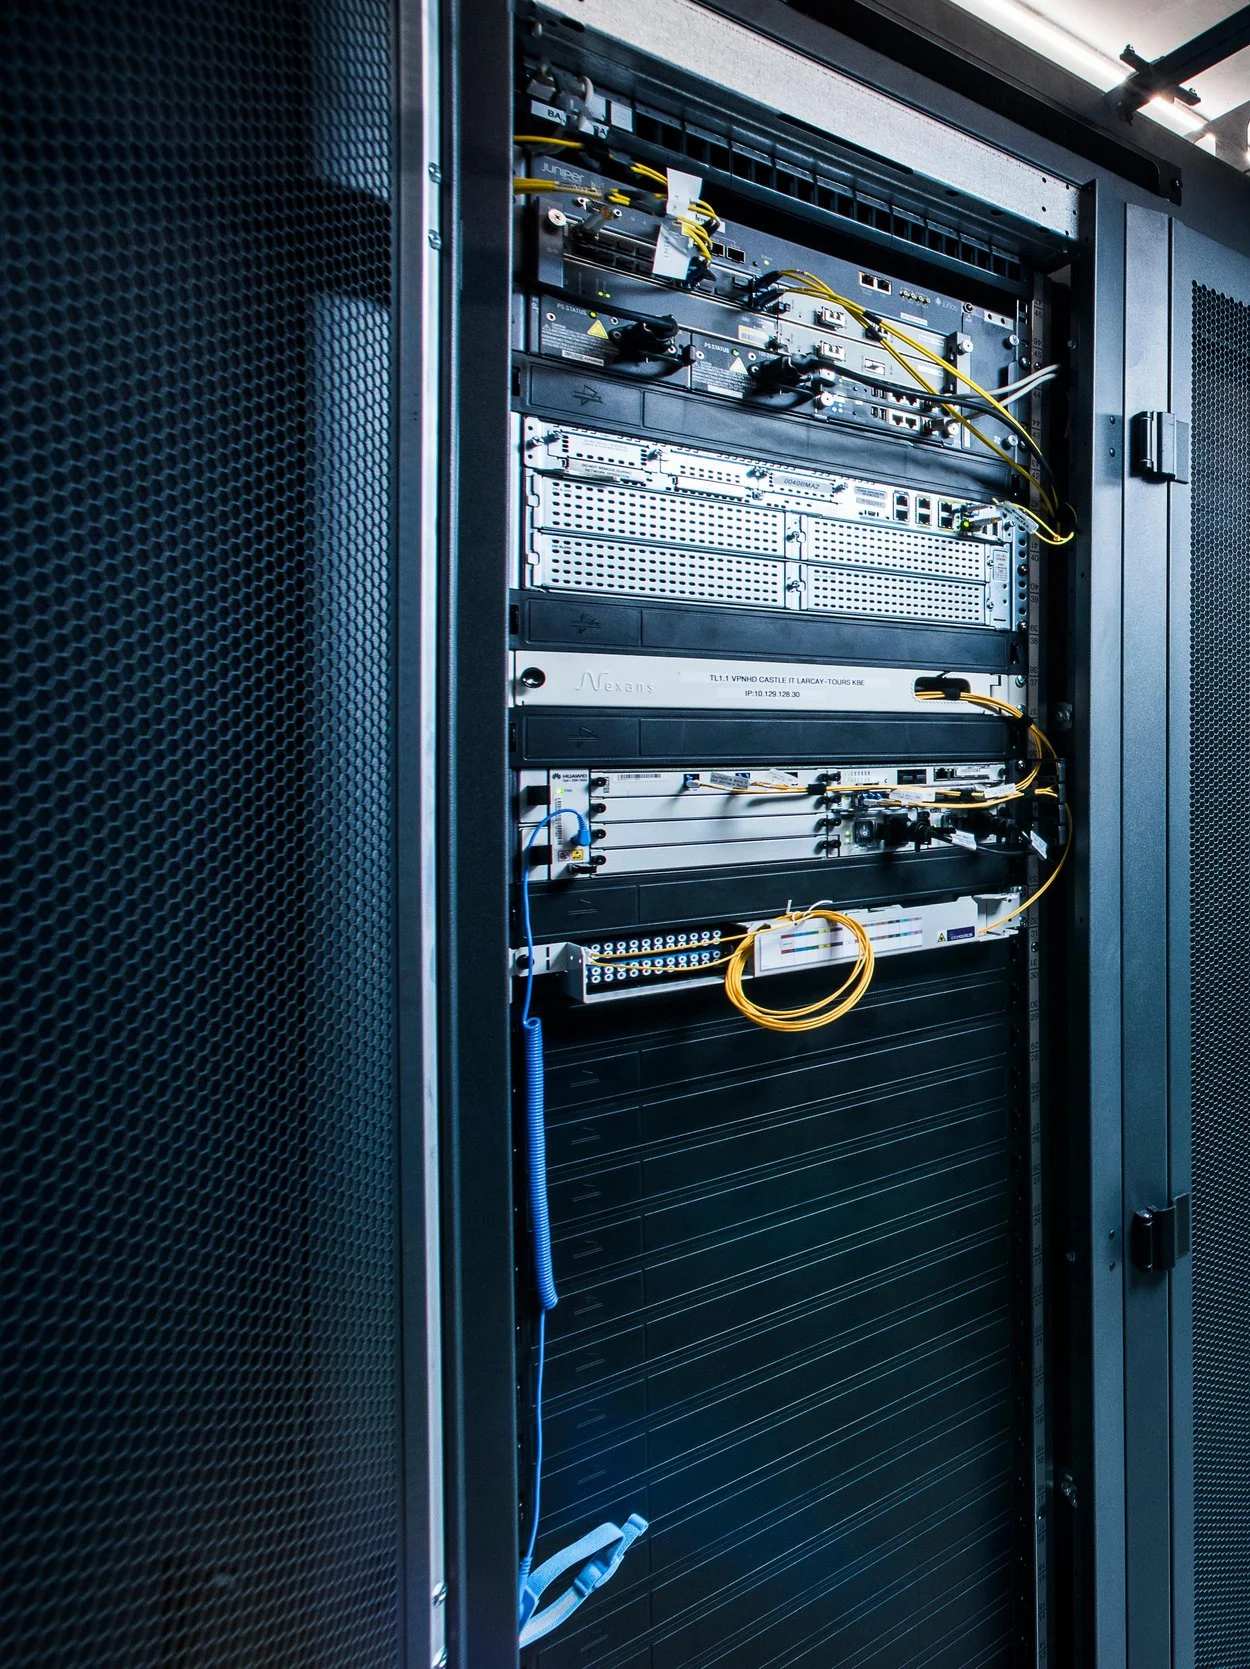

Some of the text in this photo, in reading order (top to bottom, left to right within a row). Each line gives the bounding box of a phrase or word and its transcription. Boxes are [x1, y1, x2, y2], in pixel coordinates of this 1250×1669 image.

[575, 671, 656, 693] Nexans
[731, 675, 757, 683] VPNHD
[744, 689, 801, 698] IP:10.129.128.30
